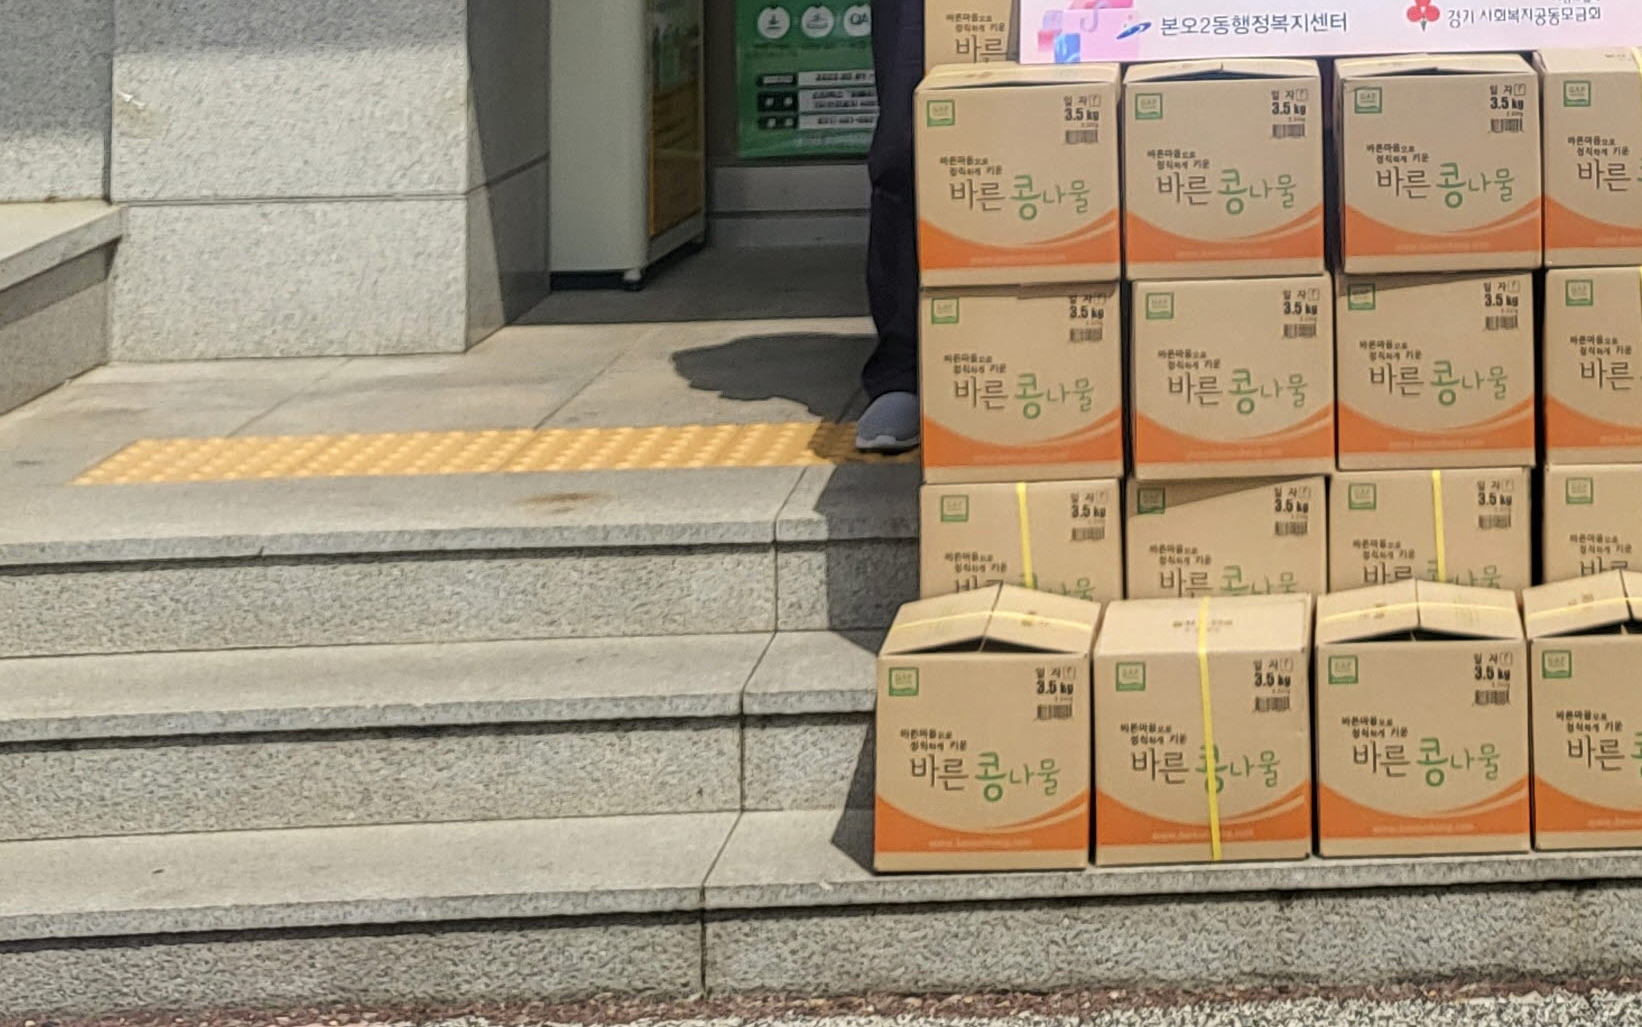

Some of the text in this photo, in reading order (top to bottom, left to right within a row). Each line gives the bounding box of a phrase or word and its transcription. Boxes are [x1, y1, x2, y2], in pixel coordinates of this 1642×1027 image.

[1160, 12, 1347, 37] 본오2동행정복지센터
[1447, 7, 1602, 28] 경기 사회복지공동모금회
[1065, 108, 1099, 122] 3.5 kg
[1272, 102, 1306, 116] 3.5 kg
[1490, 97, 1524, 111] 3.5 kg
[1157, 169, 1296, 215] 바른 콩나물
[1377, 162, 1515, 209] 바른 콩나물
[1577, 158, 1632, 193] 바른
[949, 175, 1090, 220] 바른 콩나물
[1070, 306, 1104, 320] 3.5 kg
[1283, 302, 1317, 315] 3.5 kg
[1485, 294, 1518, 308] 3.5 kg
[1168, 368, 1308, 415] 바른 콩나물
[1369, 360, 1508, 406] 바른 콩나물
[1579, 358, 1635, 391] 바른
[954, 374, 1094, 419] 바른 콩나물
[1479, 493, 1512, 506] 3.5 kg
[1475, 666, 1510, 681] 3.5 kg
[1131, 748, 1189, 785] 바른
[1352, 738, 1499, 787] 바른 콩나물
[1567, 735, 1625, 773] 바른
[910, 751, 1061, 802] 바른 콩나물
